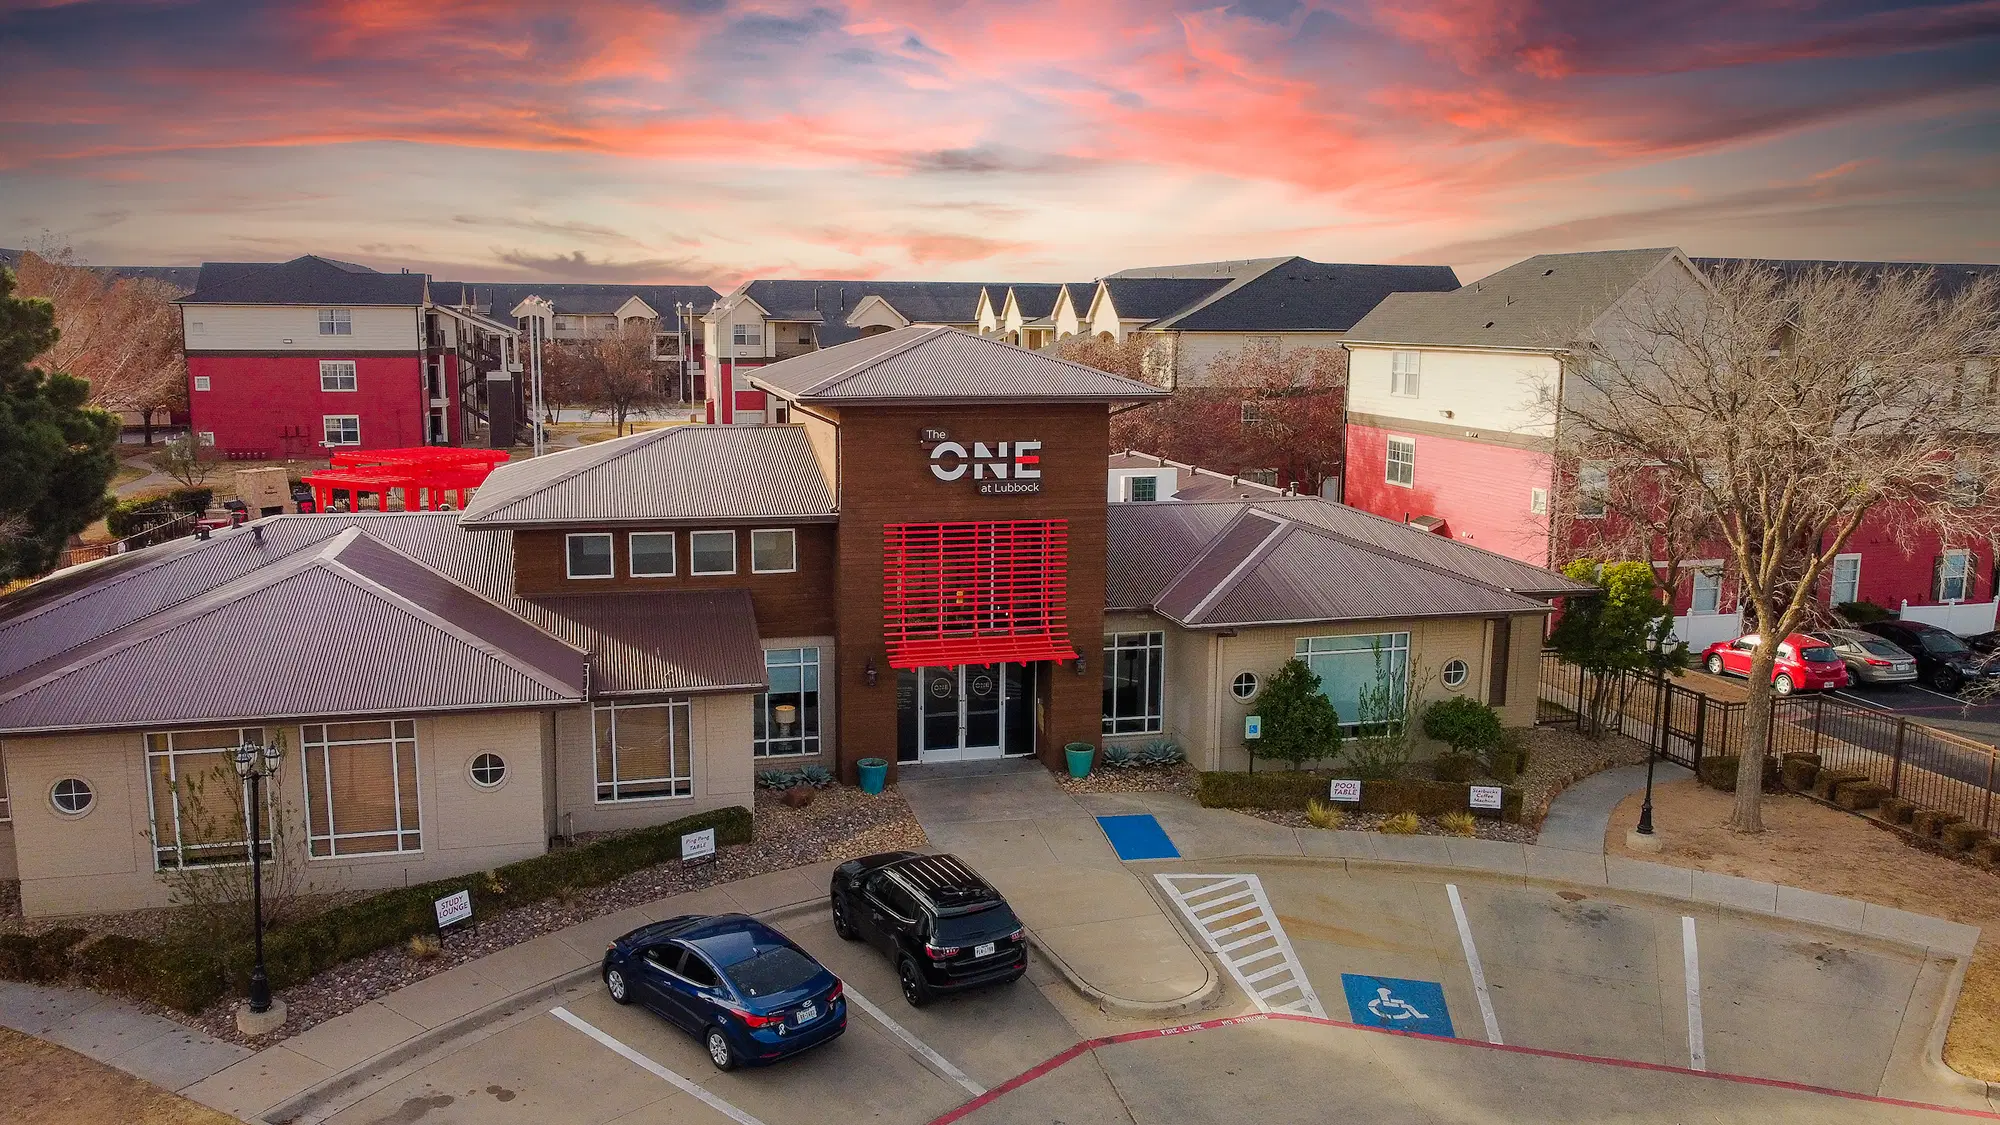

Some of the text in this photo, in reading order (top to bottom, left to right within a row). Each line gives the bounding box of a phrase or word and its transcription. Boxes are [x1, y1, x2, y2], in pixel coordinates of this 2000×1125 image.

[926, 429, 946, 439] The
[930, 441, 1042, 481] ONE
[981, 483, 1040, 493] at Lubbock
[690, 841, 707, 851] TABLE
[439, 901, 468, 919] LOUNGE
[441, 895, 463, 910] STUDY
[1160, 1015, 1269, 1036] FIRE LANE NO PARKING
